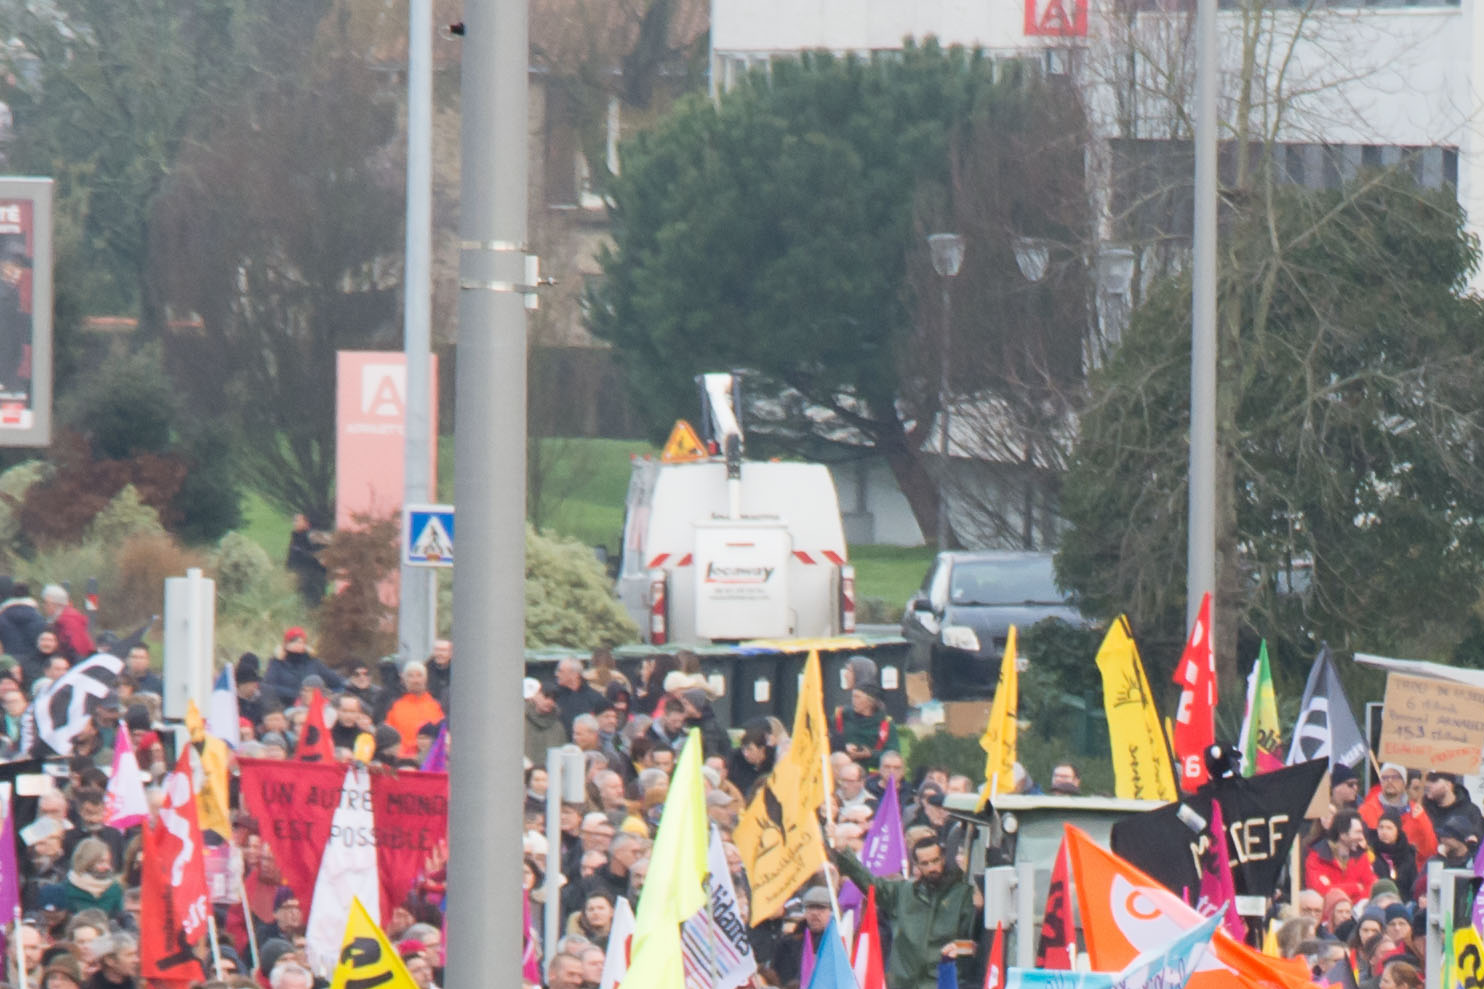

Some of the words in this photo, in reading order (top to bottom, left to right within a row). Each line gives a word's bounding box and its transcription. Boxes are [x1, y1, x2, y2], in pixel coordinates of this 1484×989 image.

[306, 784, 374, 813] AUTRE
[386, 793, 447, 816] MOND
[274, 819, 313, 841] EST
